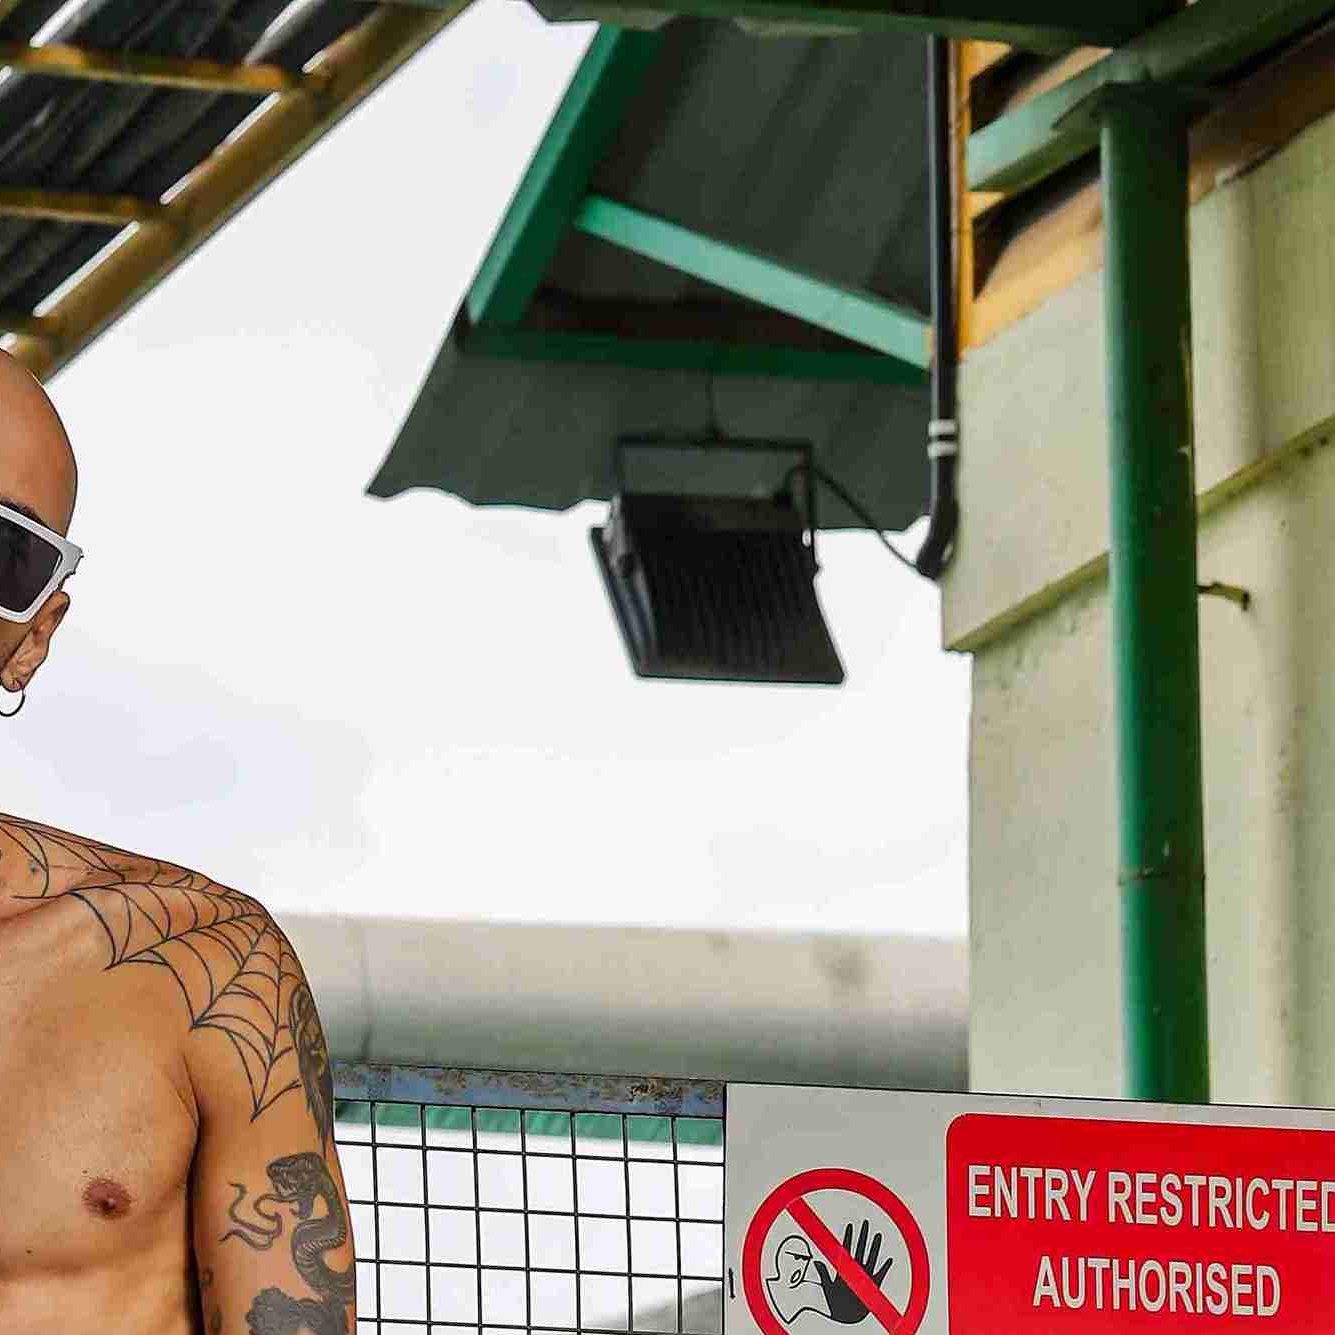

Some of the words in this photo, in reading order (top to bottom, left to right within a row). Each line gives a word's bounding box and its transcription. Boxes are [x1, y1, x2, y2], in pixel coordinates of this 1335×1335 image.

[968, 1165, 1097, 1222] ENTRY
[1108, 1171, 1335, 1234] RESTRICTED
[1033, 1255, 1281, 1317] AUTHORISED
